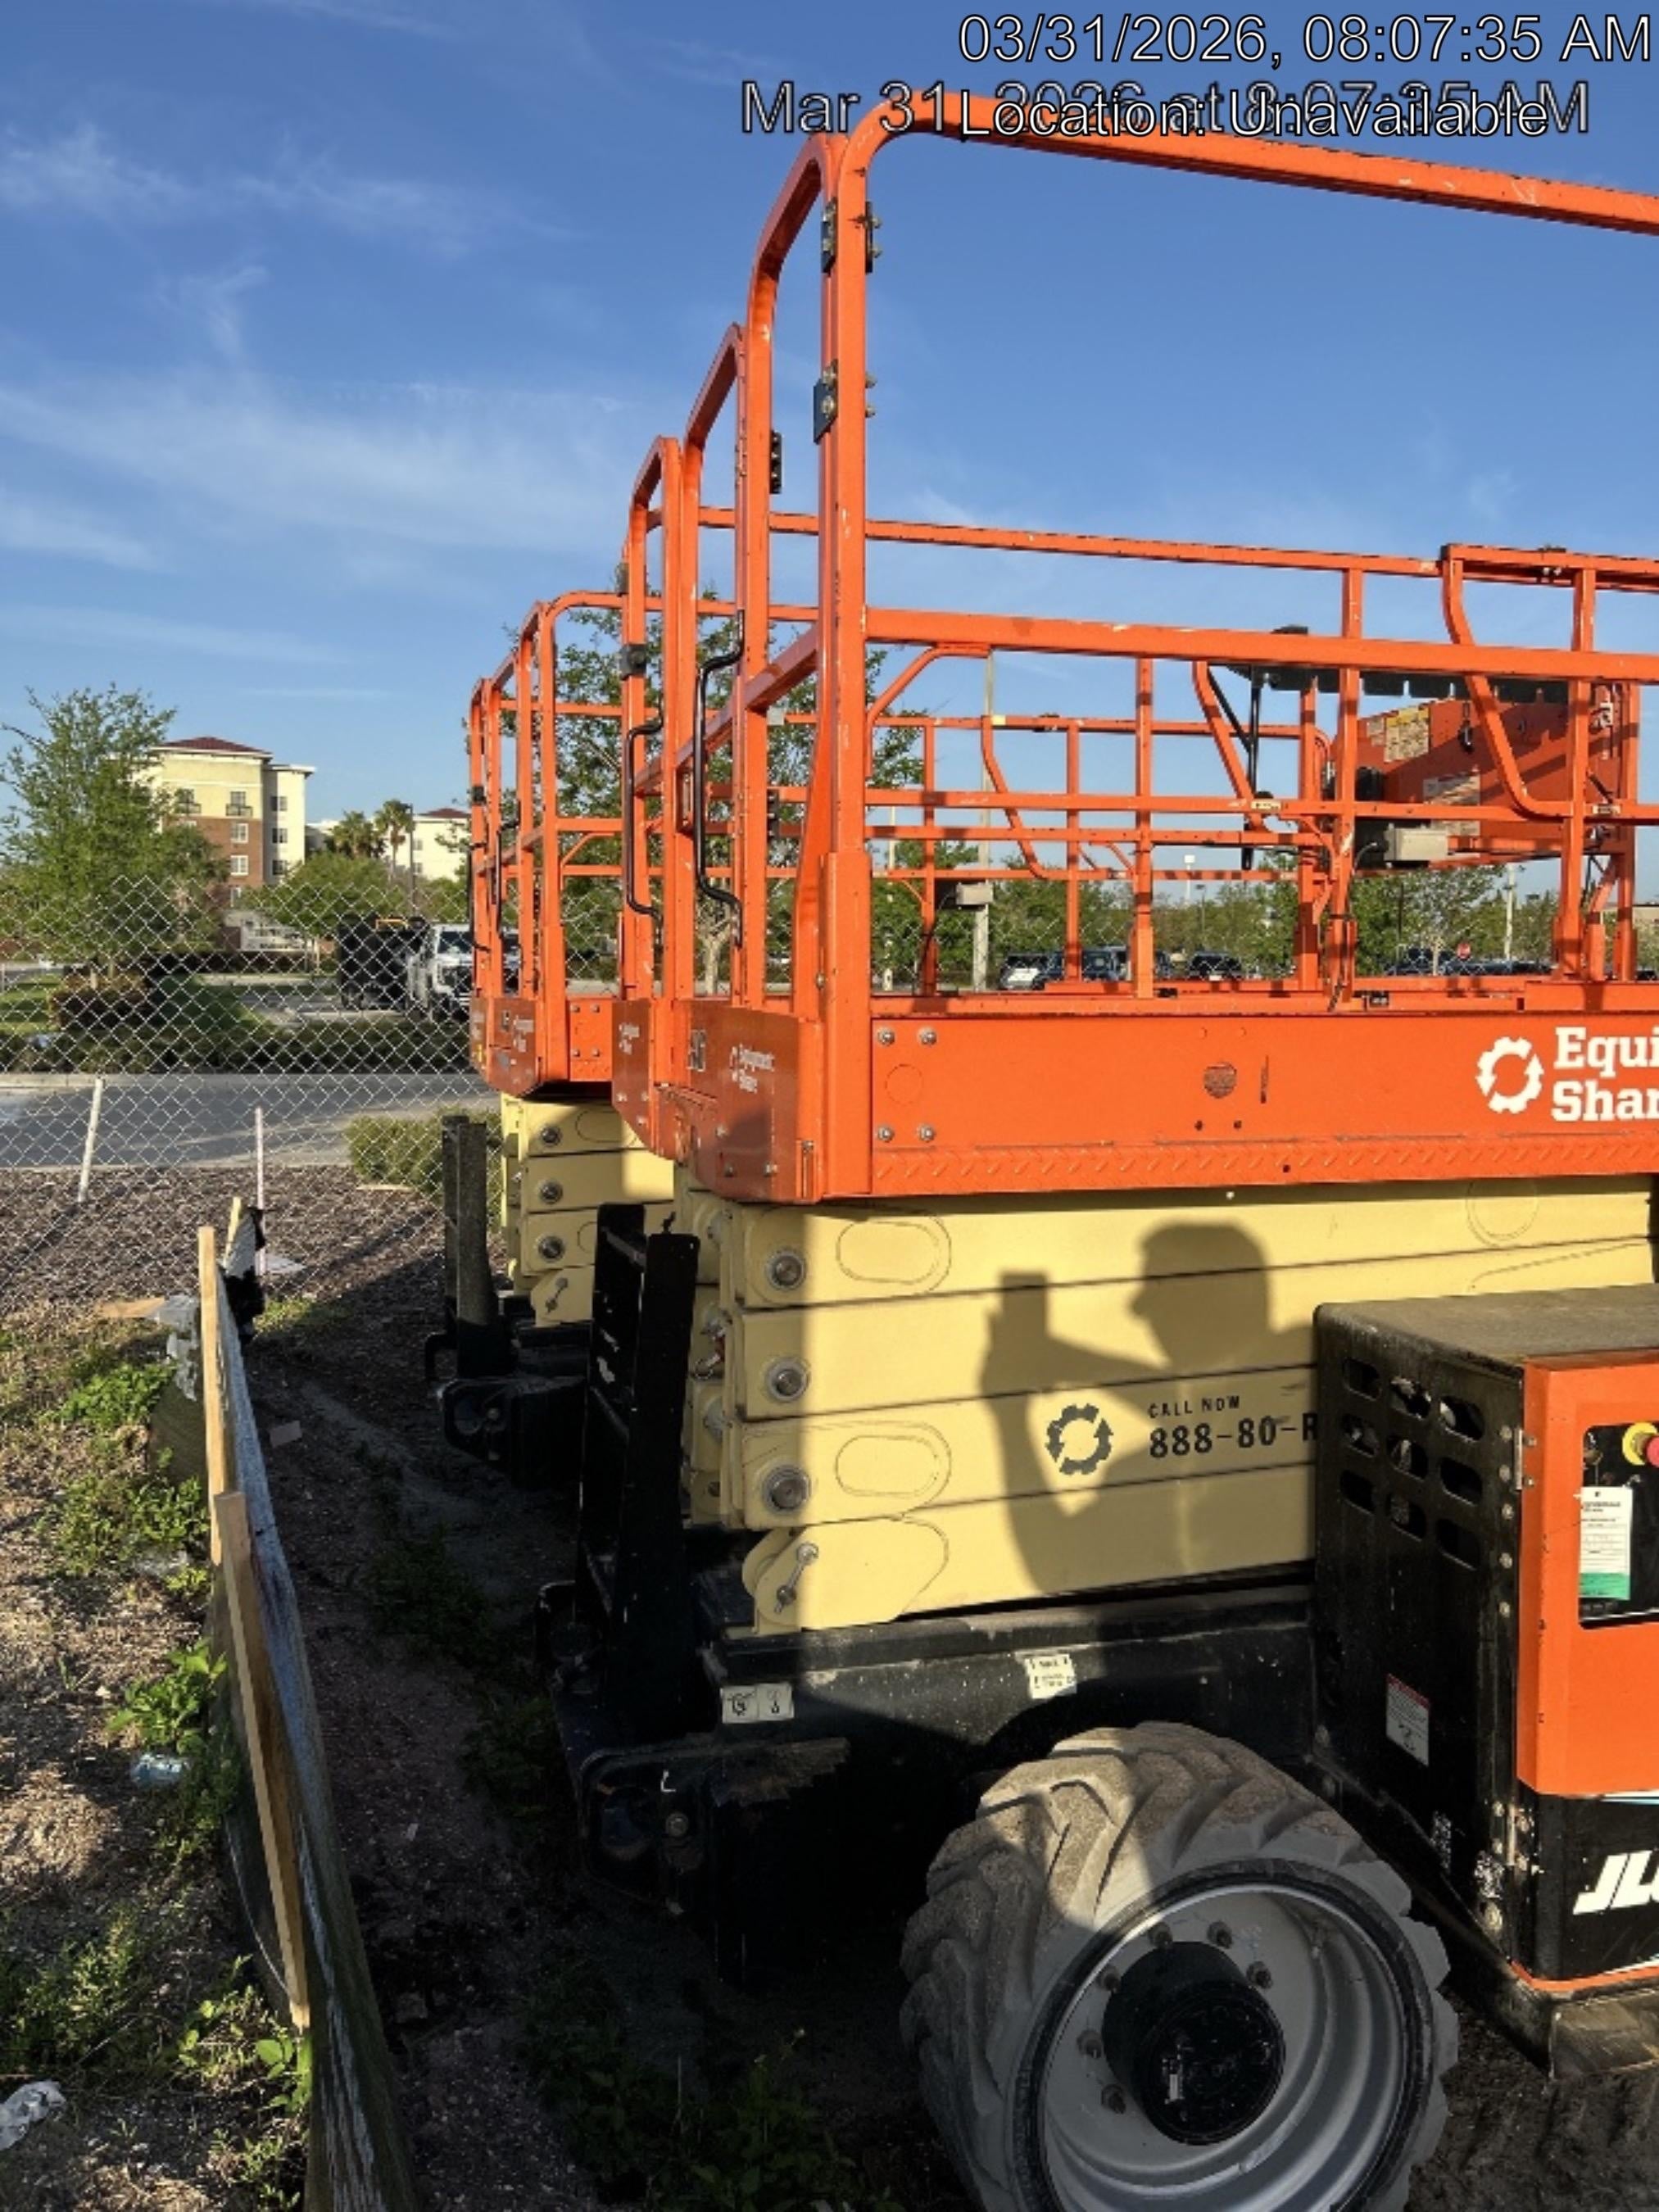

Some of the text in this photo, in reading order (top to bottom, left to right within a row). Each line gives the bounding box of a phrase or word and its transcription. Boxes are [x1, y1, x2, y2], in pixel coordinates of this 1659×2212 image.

[1148, 1395, 1240, 1418] CALL NOW
[1572, 1850, 1659, 1915] JL
